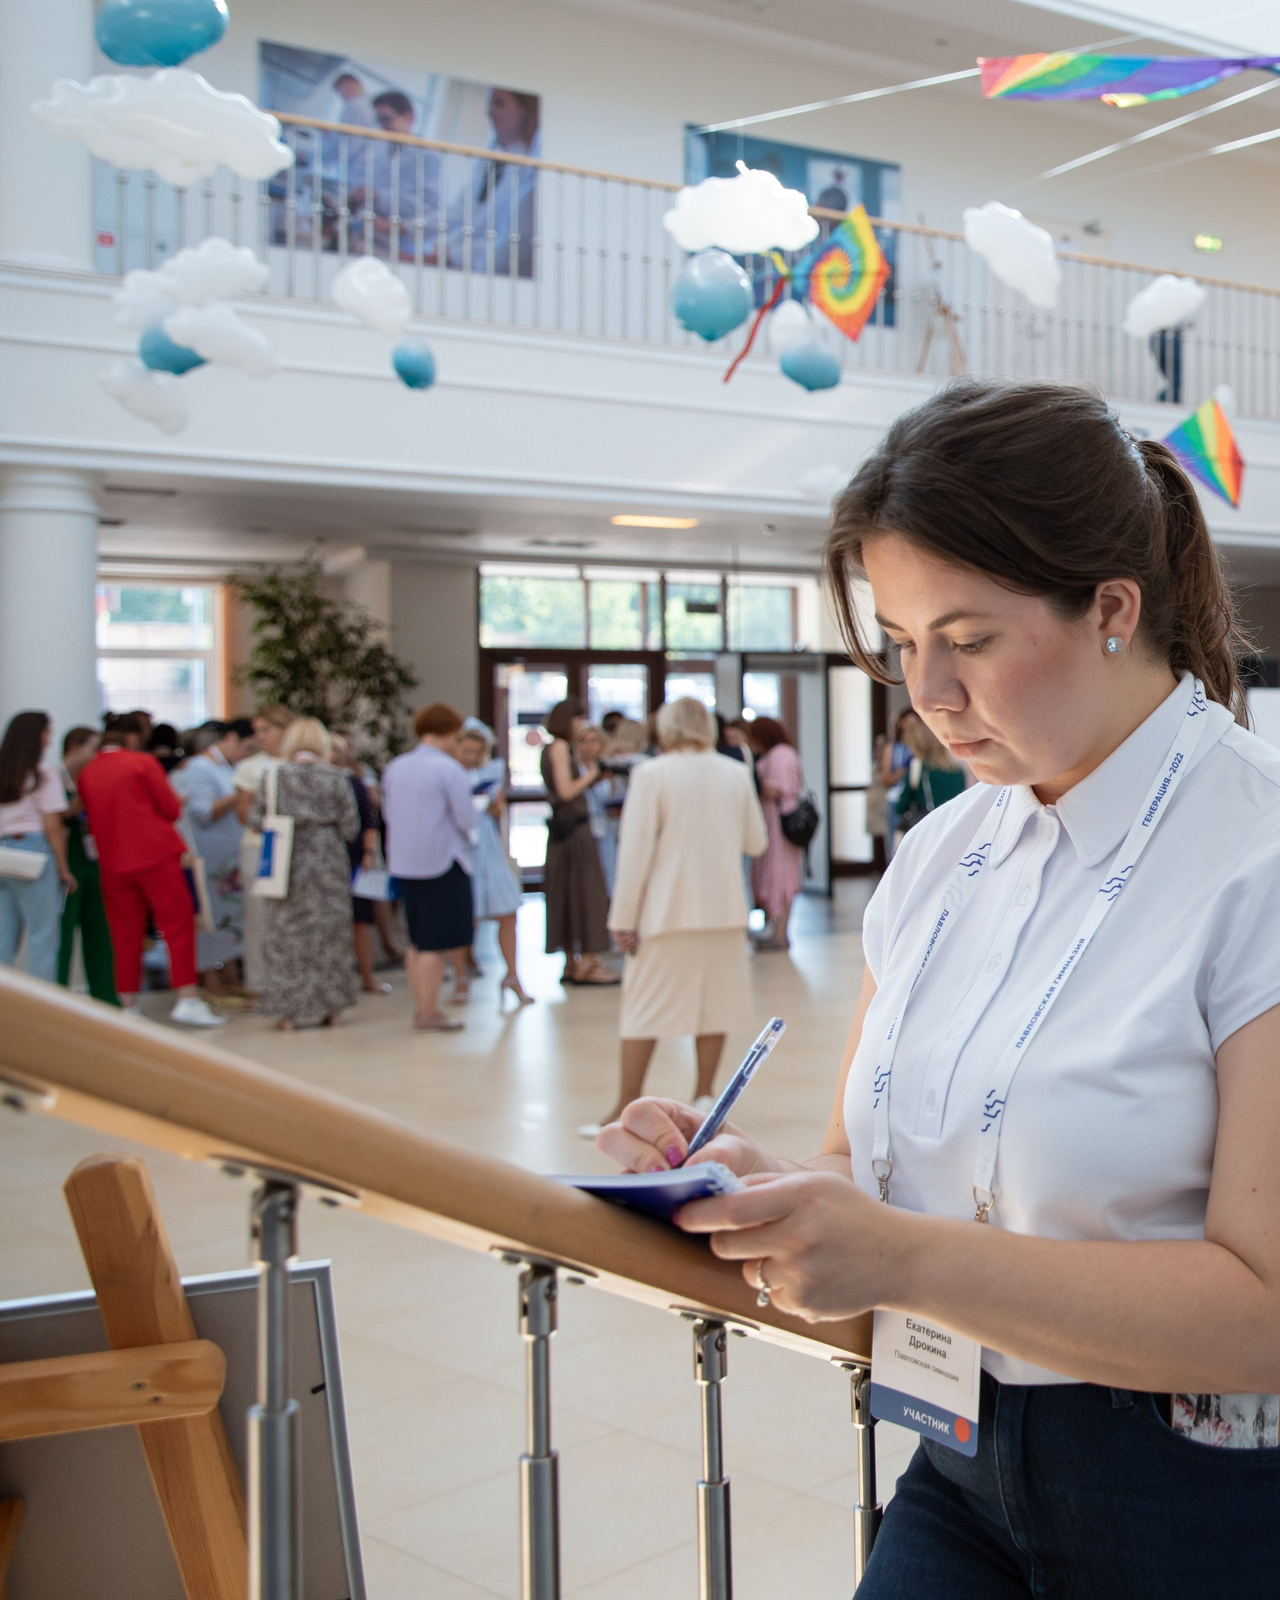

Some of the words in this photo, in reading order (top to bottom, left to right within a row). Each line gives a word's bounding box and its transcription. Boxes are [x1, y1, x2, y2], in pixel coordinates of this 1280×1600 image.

[1015, 986, 1056, 1049] ПАВЛОВСКАЯ
[1053, 938, 1086, 985] ГИМНАЗИЯ
[906, 1318, 952, 1345] Екатерина
[894, 1350, 931, 1370] Павловская
[909, 1335, 947, 1359] Дрокина
[903, 1406, 950, 1434] УЧАСТНИК
